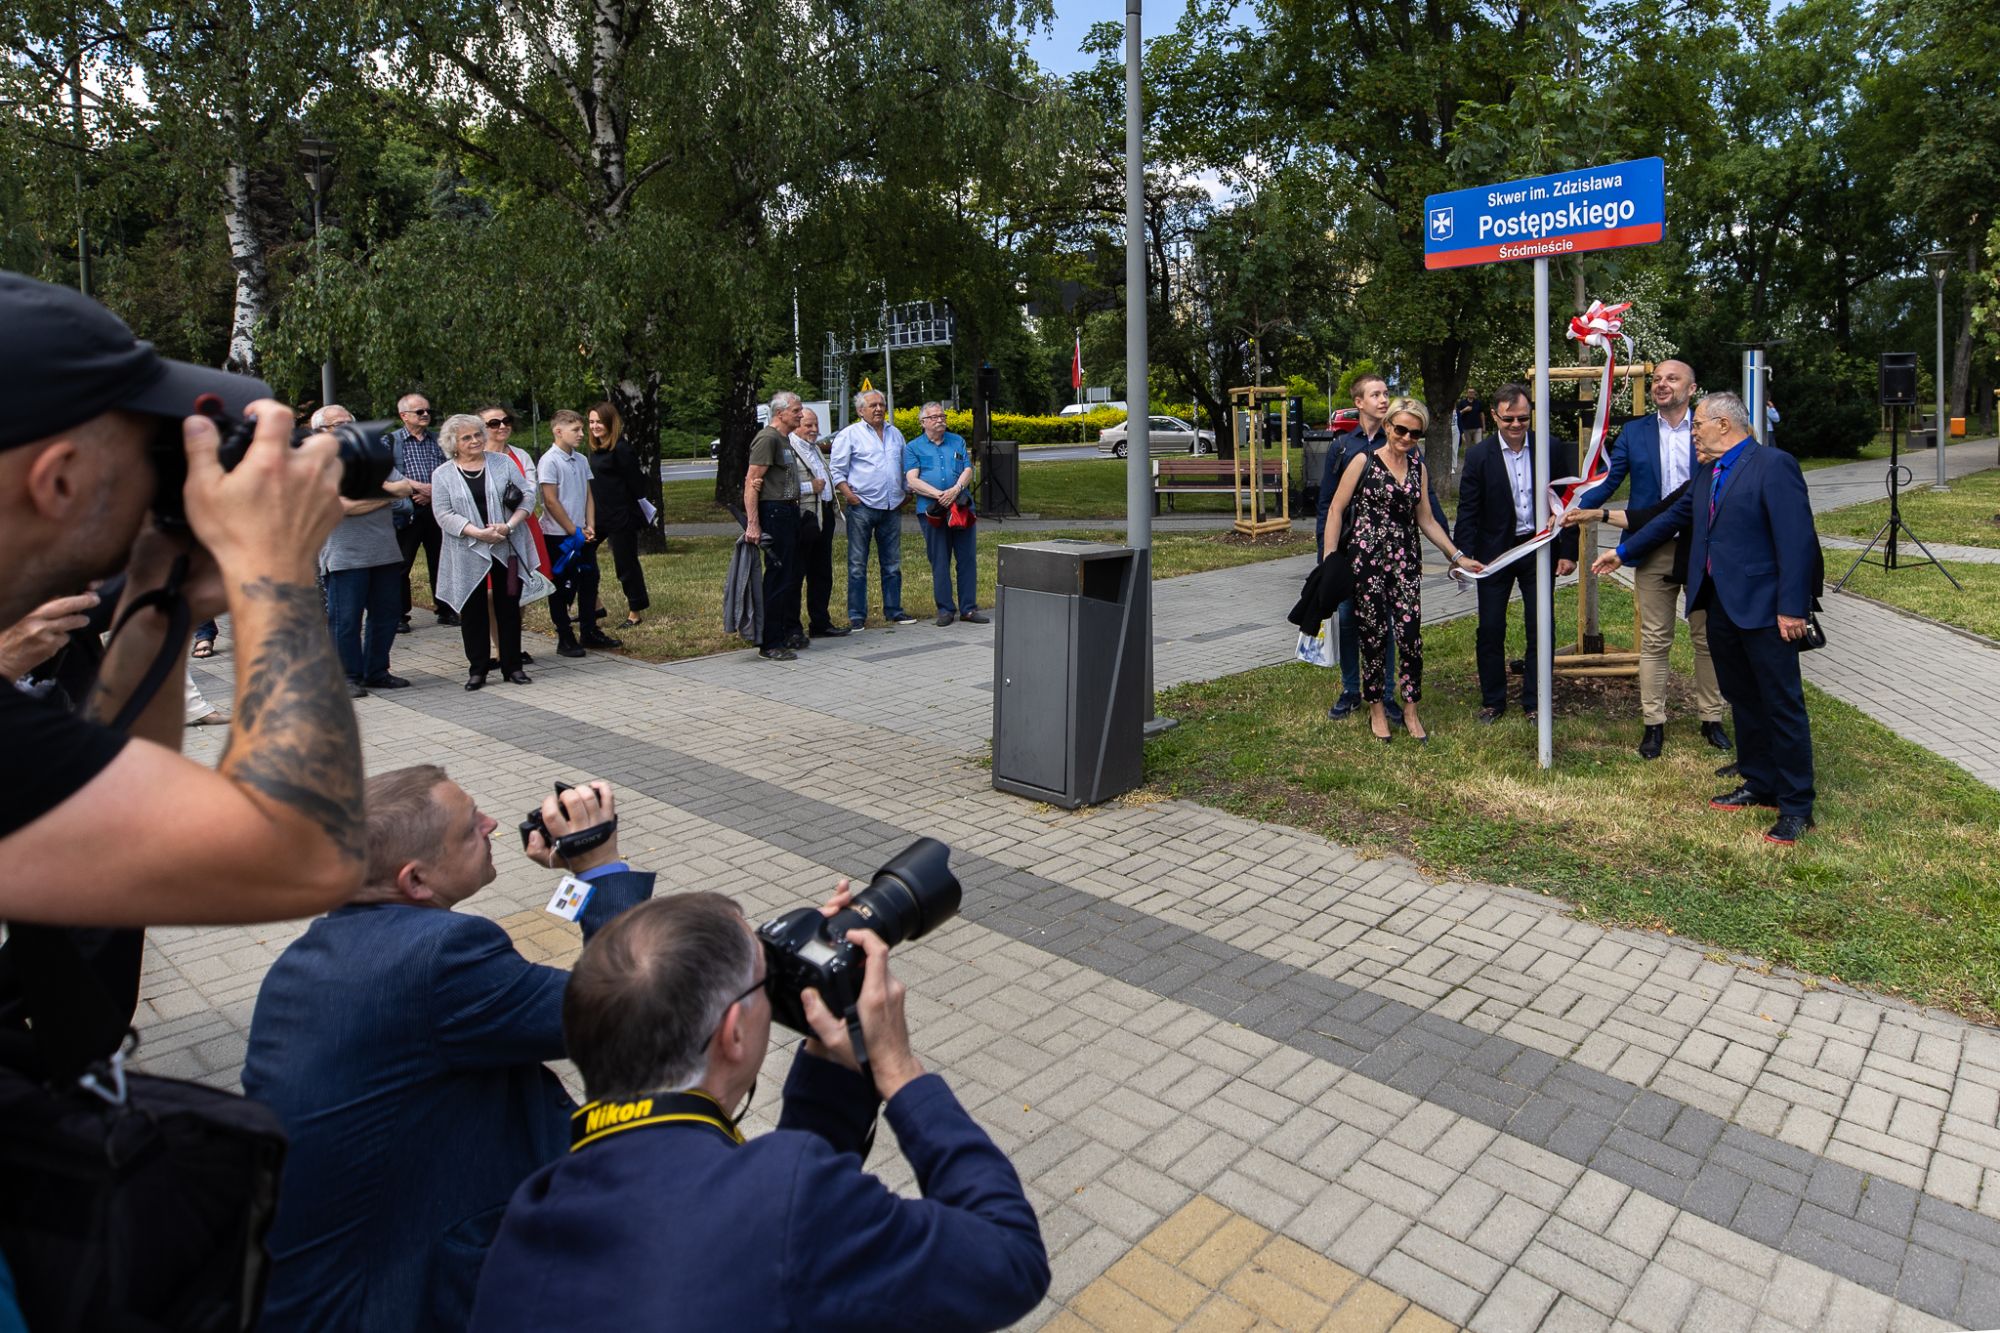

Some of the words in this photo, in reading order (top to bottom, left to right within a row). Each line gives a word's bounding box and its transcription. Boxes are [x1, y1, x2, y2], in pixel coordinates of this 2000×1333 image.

[1488, 192, 1527, 208] Skwer
[1530, 187, 1549, 200] im.
[1553, 175, 1622, 197] Zdzisława
[1479, 199, 1635, 239] Postępskiego
[1499, 239, 1573, 259] Śródmieście
[586, 1098, 654, 1134] Nikon
